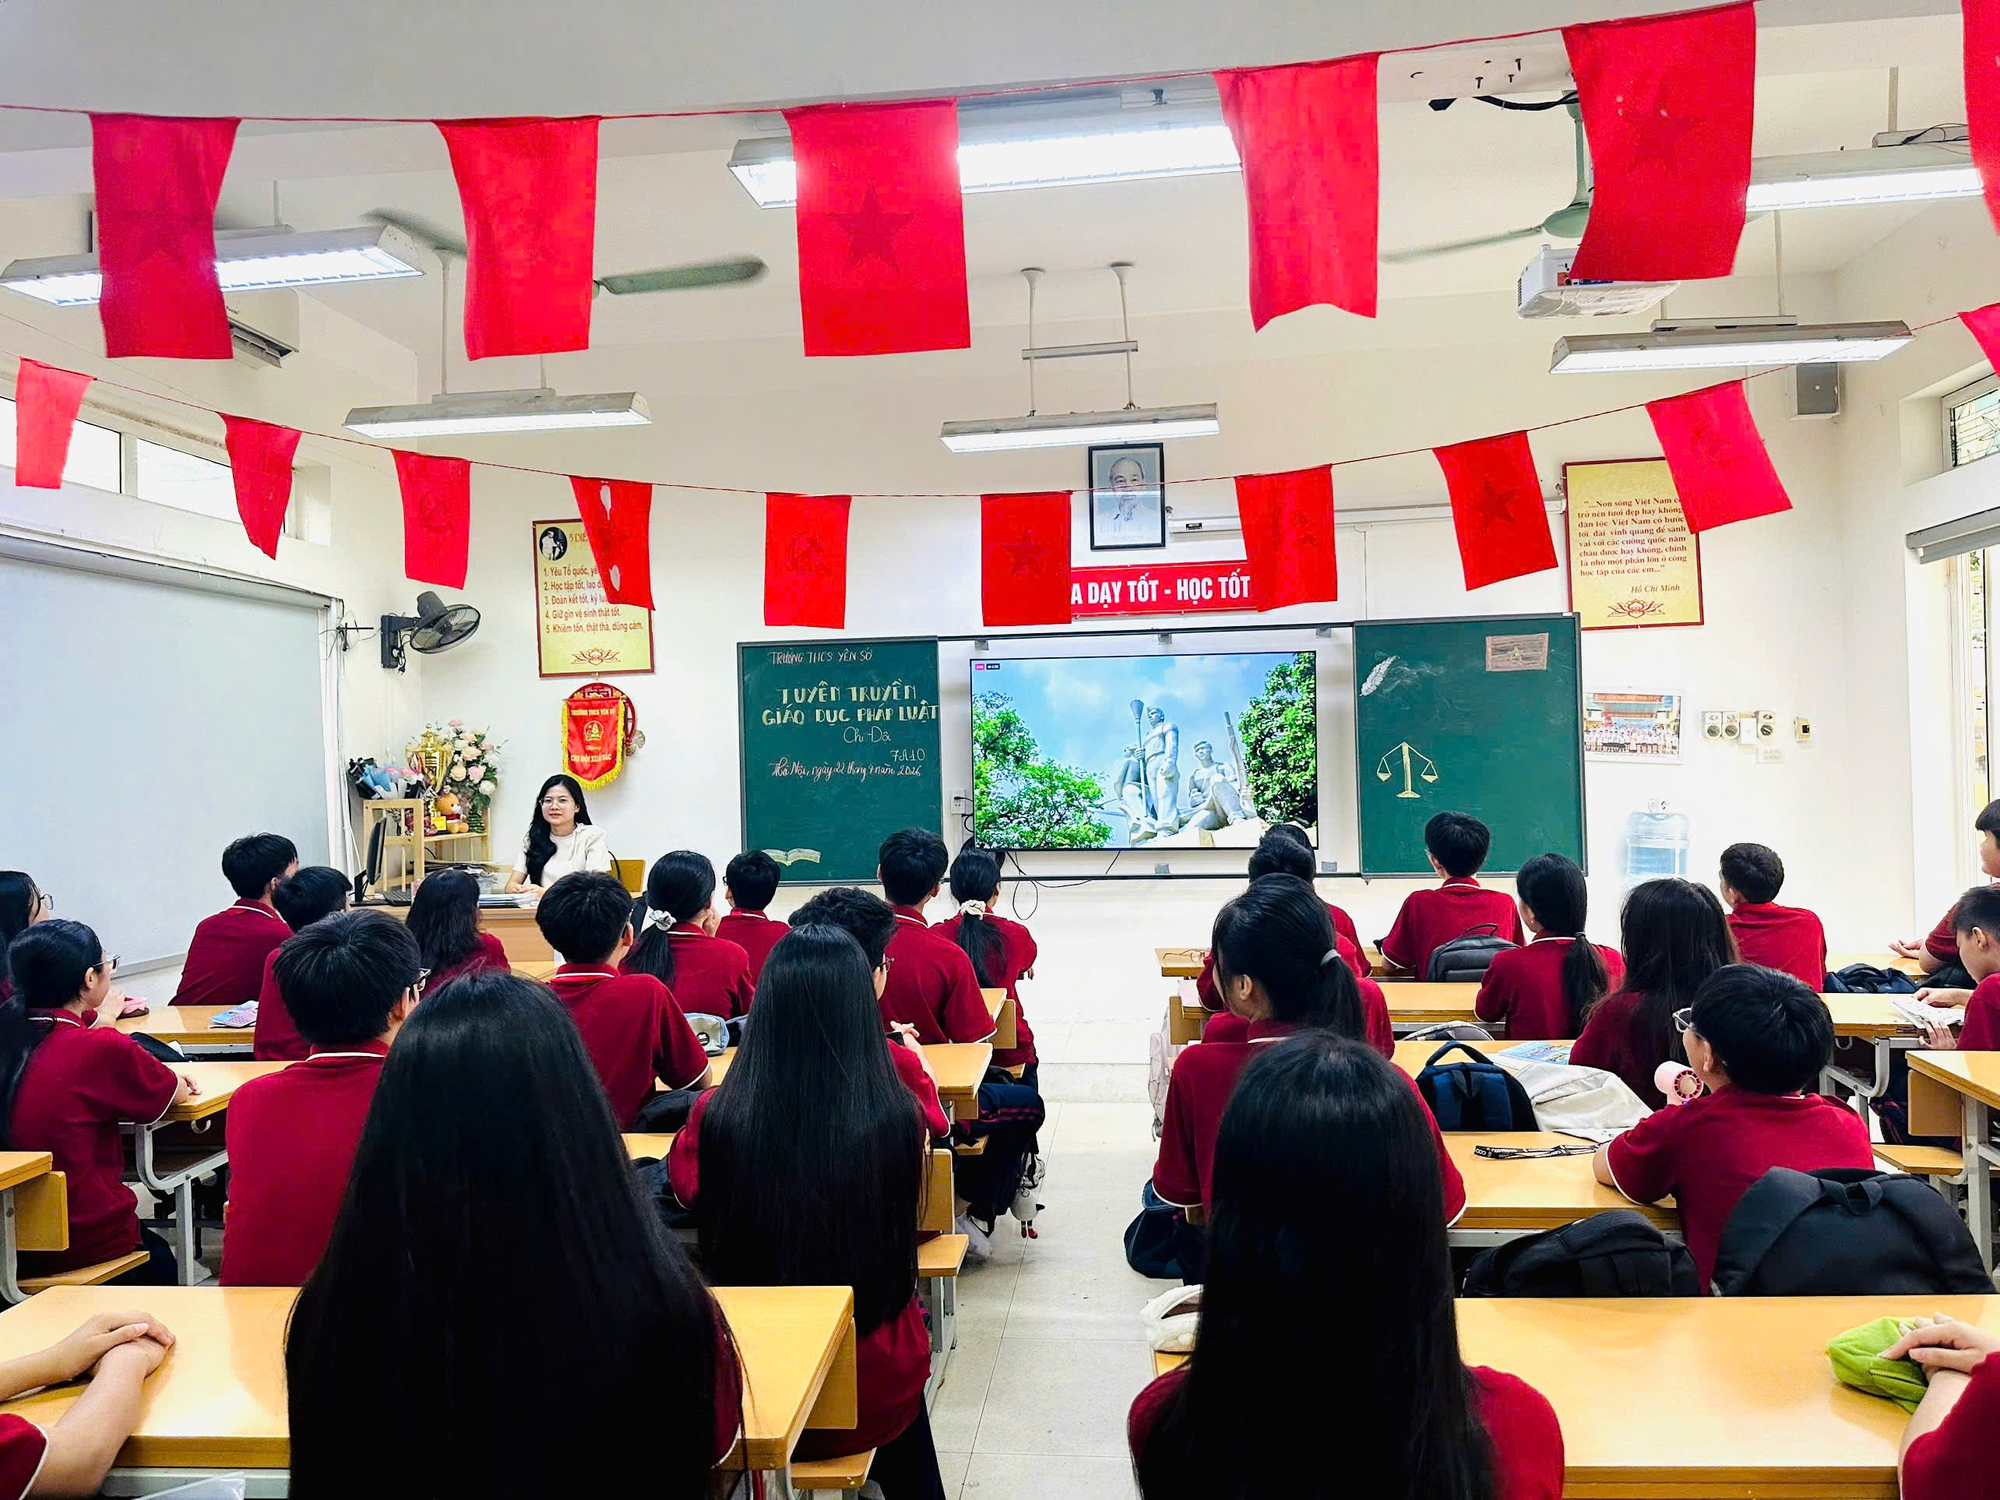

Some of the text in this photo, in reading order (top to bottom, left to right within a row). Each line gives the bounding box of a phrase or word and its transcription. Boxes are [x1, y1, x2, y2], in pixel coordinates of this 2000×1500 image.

[1653, 497, 1672, 505] Nam
[1088, 581, 1122, 609] DẠY
[1127, 572, 1159, 603] TỐT
[1176, 577, 1213, 605] HỌC
[1218, 568, 1250, 599] TỐT
[1660, 584, 1680, 592] Minh
[807, 651, 833, 663] THCS
[838, 648, 856, 662] YÊN
[776, 678, 916, 704] TUYÊN TRUYỀN
[815, 708, 850, 726] DỤC
[857, 703, 893, 722] PHÁP
[899, 699, 939, 723] LUẬT
[811, 761, 833, 782] ngày
